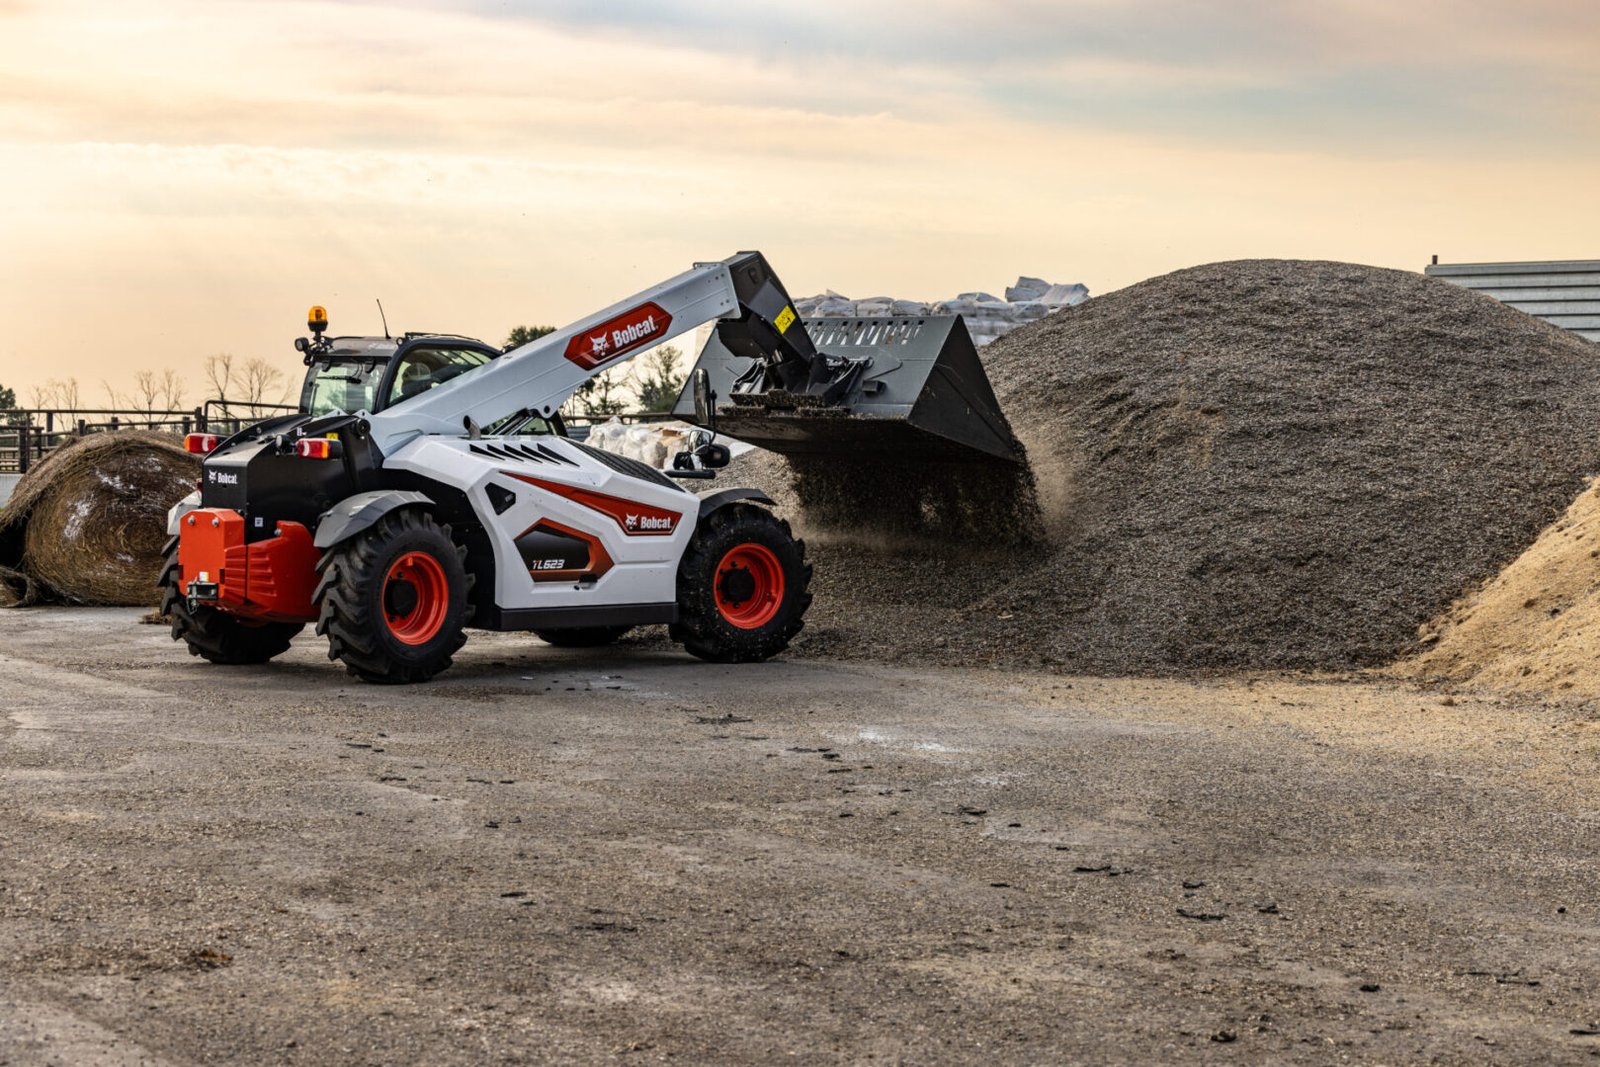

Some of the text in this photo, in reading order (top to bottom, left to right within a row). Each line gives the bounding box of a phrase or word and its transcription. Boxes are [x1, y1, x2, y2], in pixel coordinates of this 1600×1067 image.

[613, 315, 655, 340] Bobcat
[217, 473, 238, 484] Bobcat
[640, 516, 671, 529] Bobcat
[532, 559, 565, 570] TL623
